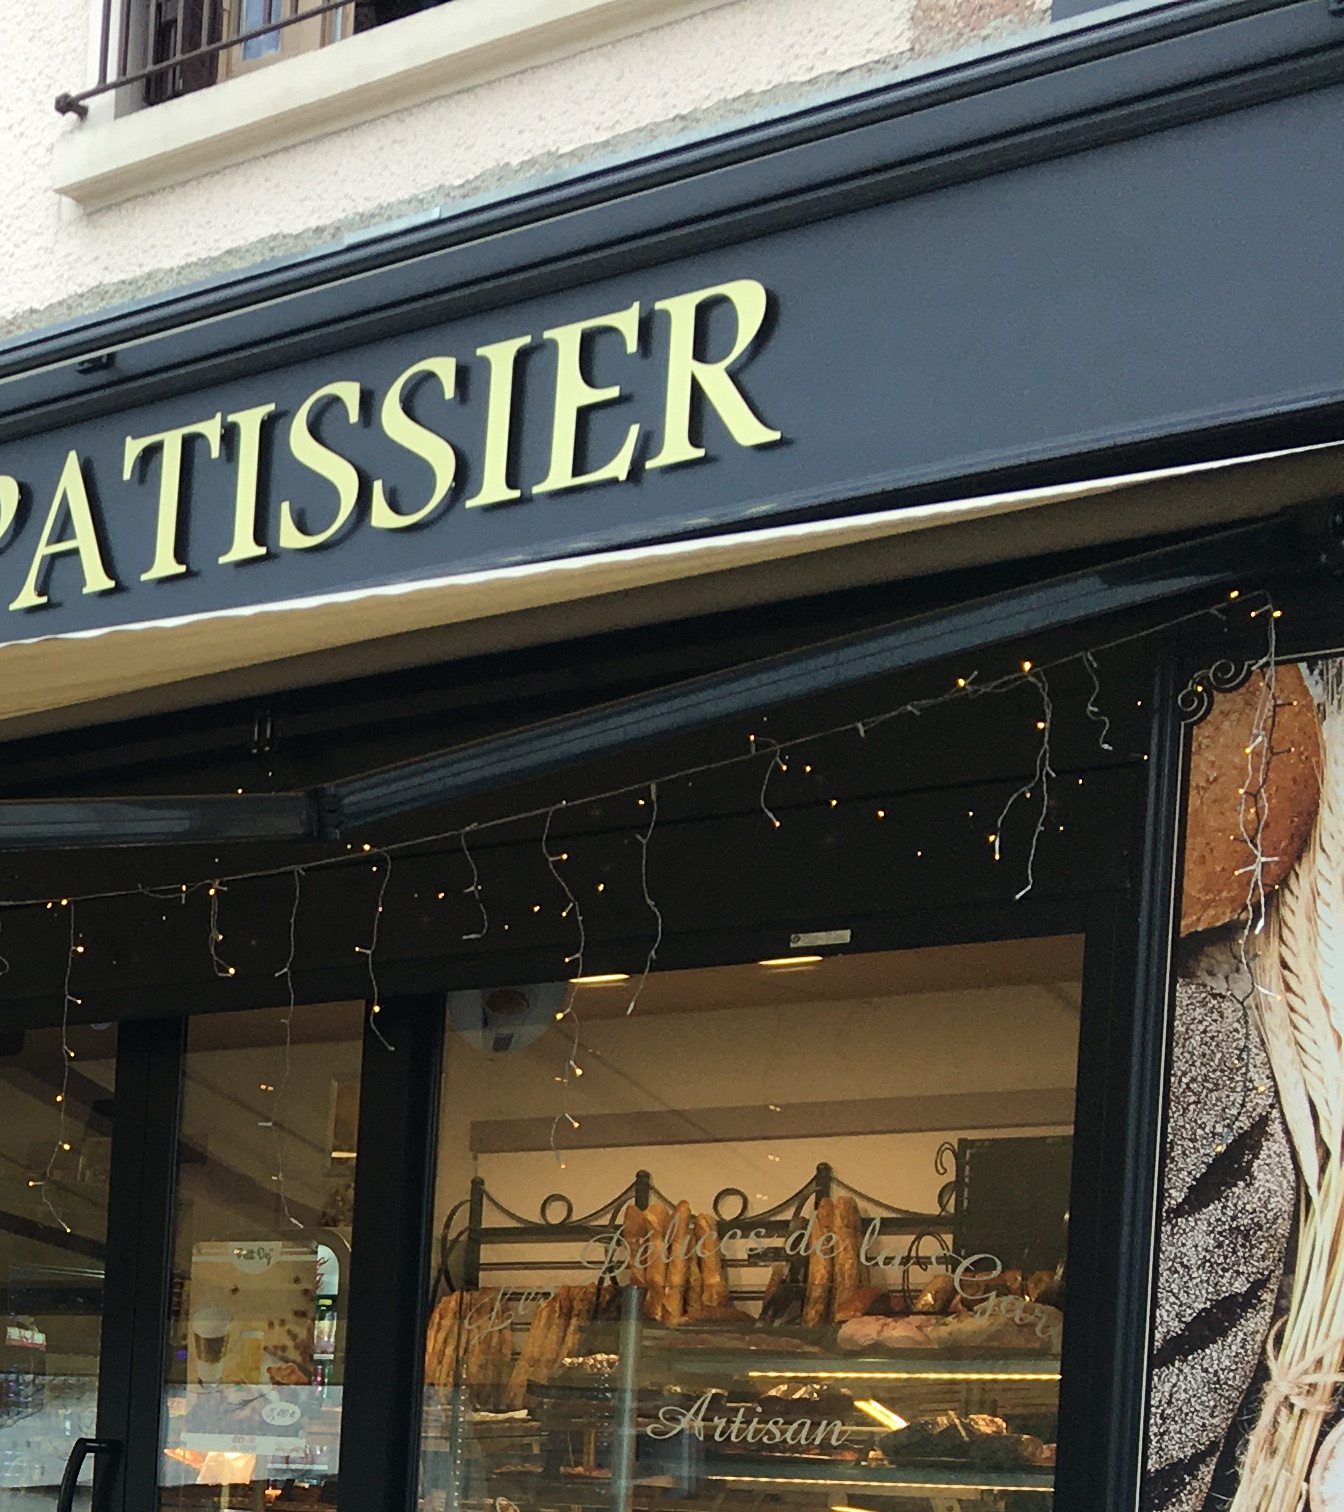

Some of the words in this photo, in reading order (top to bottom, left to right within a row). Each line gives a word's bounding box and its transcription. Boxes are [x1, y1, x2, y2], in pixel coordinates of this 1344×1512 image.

[580, 1212, 768, 1278] Délices
[784, 1211, 849, 1259] de
[859, 1216, 921, 1272] la
[646, 1392, 852, 1446] Artisan
